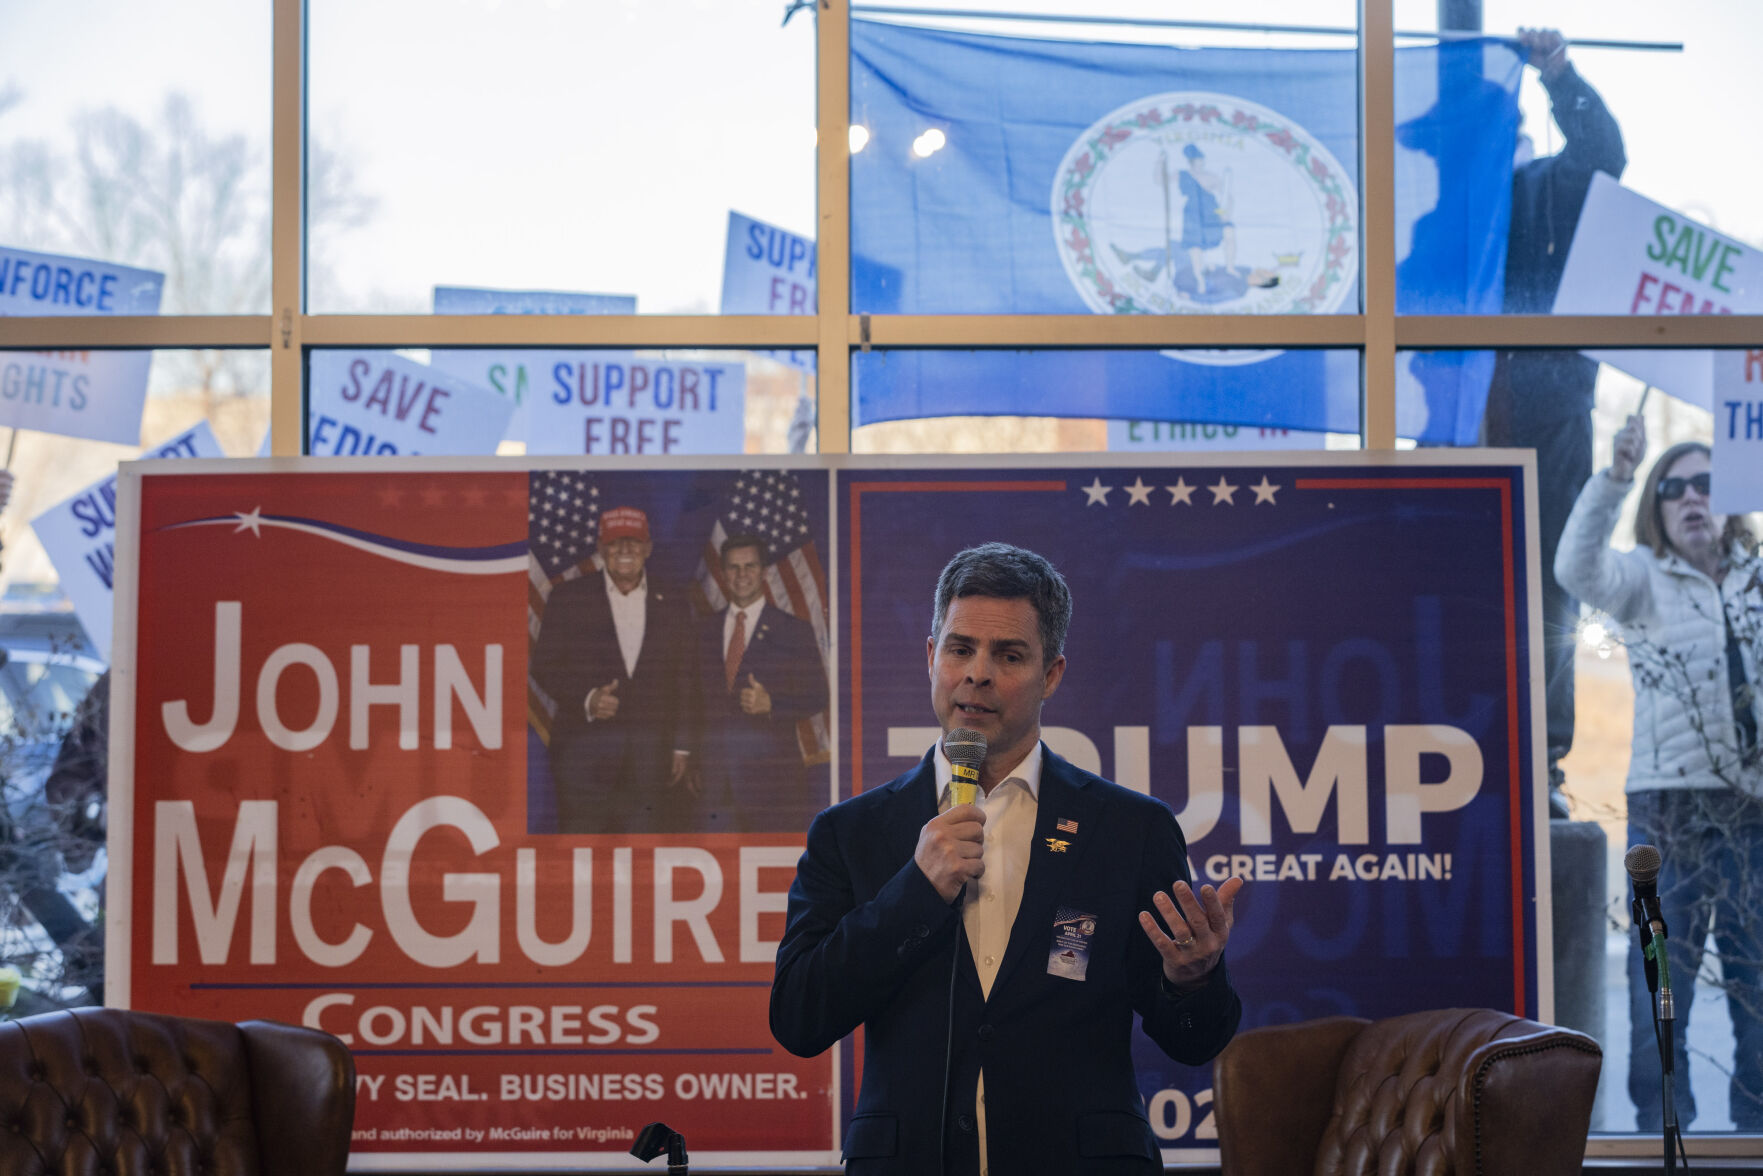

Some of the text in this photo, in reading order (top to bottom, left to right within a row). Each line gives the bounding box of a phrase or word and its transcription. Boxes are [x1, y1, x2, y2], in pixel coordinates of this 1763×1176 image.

[1646, 214, 1743, 294] SAVE
[768, 275, 816, 316] FR
[341, 357, 451, 434] SAVE
[553, 362, 724, 412] SUPPORT
[584, 416, 683, 454] FREE
[162, 601, 502, 752] JOHN
[888, 724, 1485, 846] UMP
[1205, 853, 1323, 881] GREAT
[1329, 853, 1452, 881] AGAIN!
[302, 993, 660, 1045] CONGRESS
[394, 1074, 489, 1101] SEAL.
[500, 1073, 665, 1101] BUSINESS
[674, 1073, 808, 1100] OWNER.
[351, 1126, 634, 1143] and authorized by McGuire for Virginia
